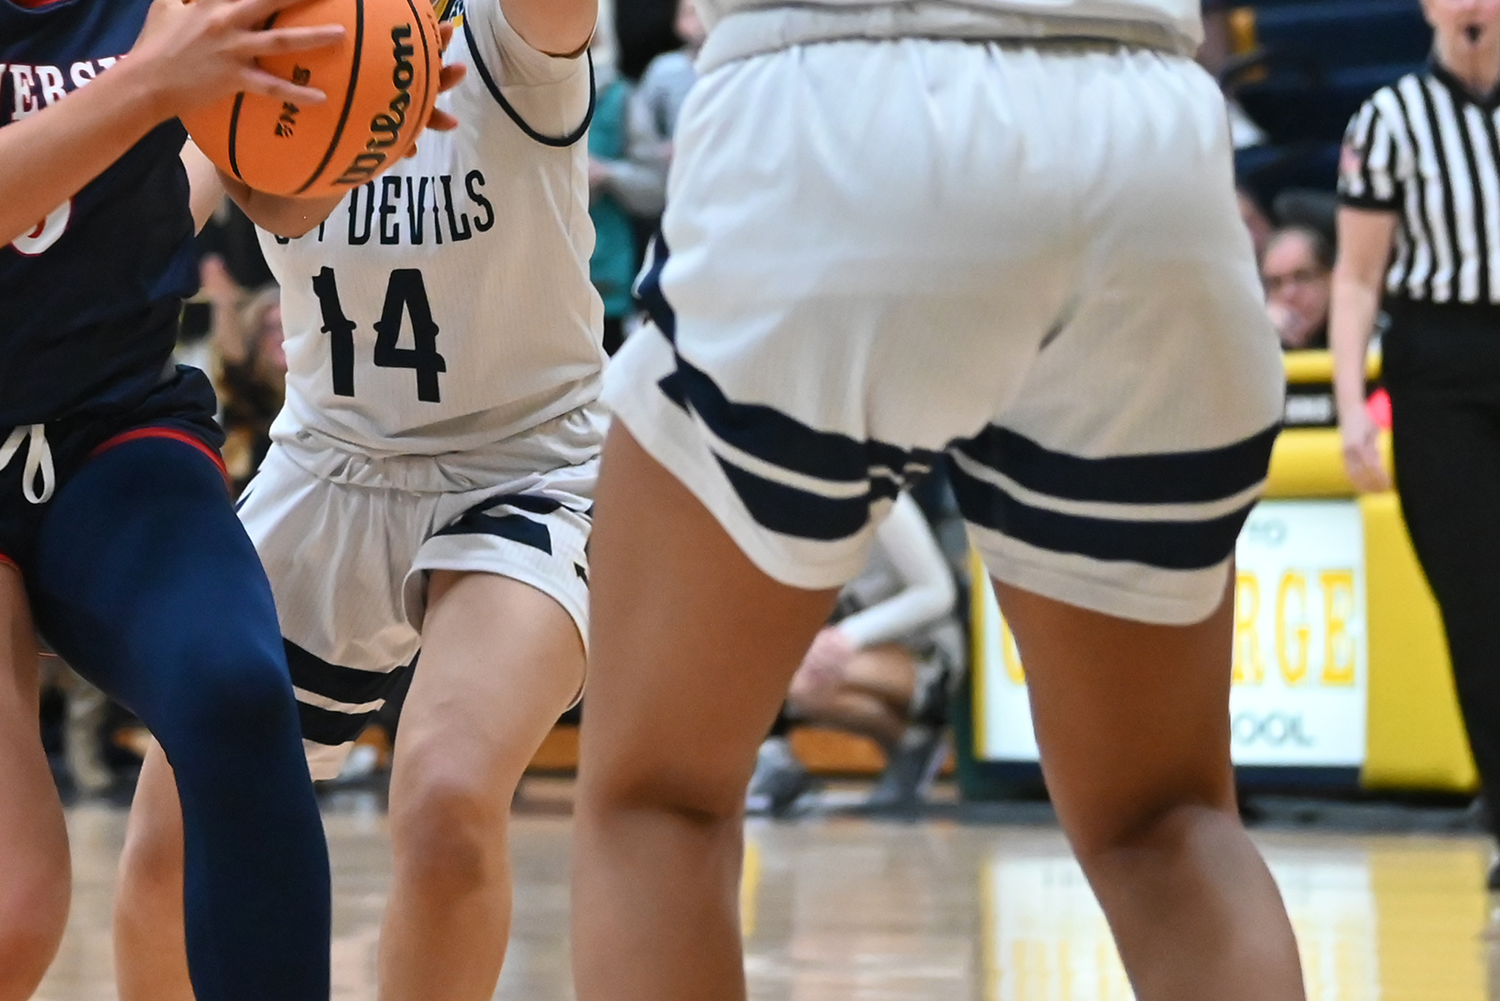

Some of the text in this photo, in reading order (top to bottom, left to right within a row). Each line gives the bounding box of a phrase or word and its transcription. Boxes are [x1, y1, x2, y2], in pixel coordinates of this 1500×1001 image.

[332, 23, 414, 186] Wilson
[348, 169, 494, 245] DEVILS
[312, 266, 446, 403] 14
[1233, 568, 1355, 687] RGE
